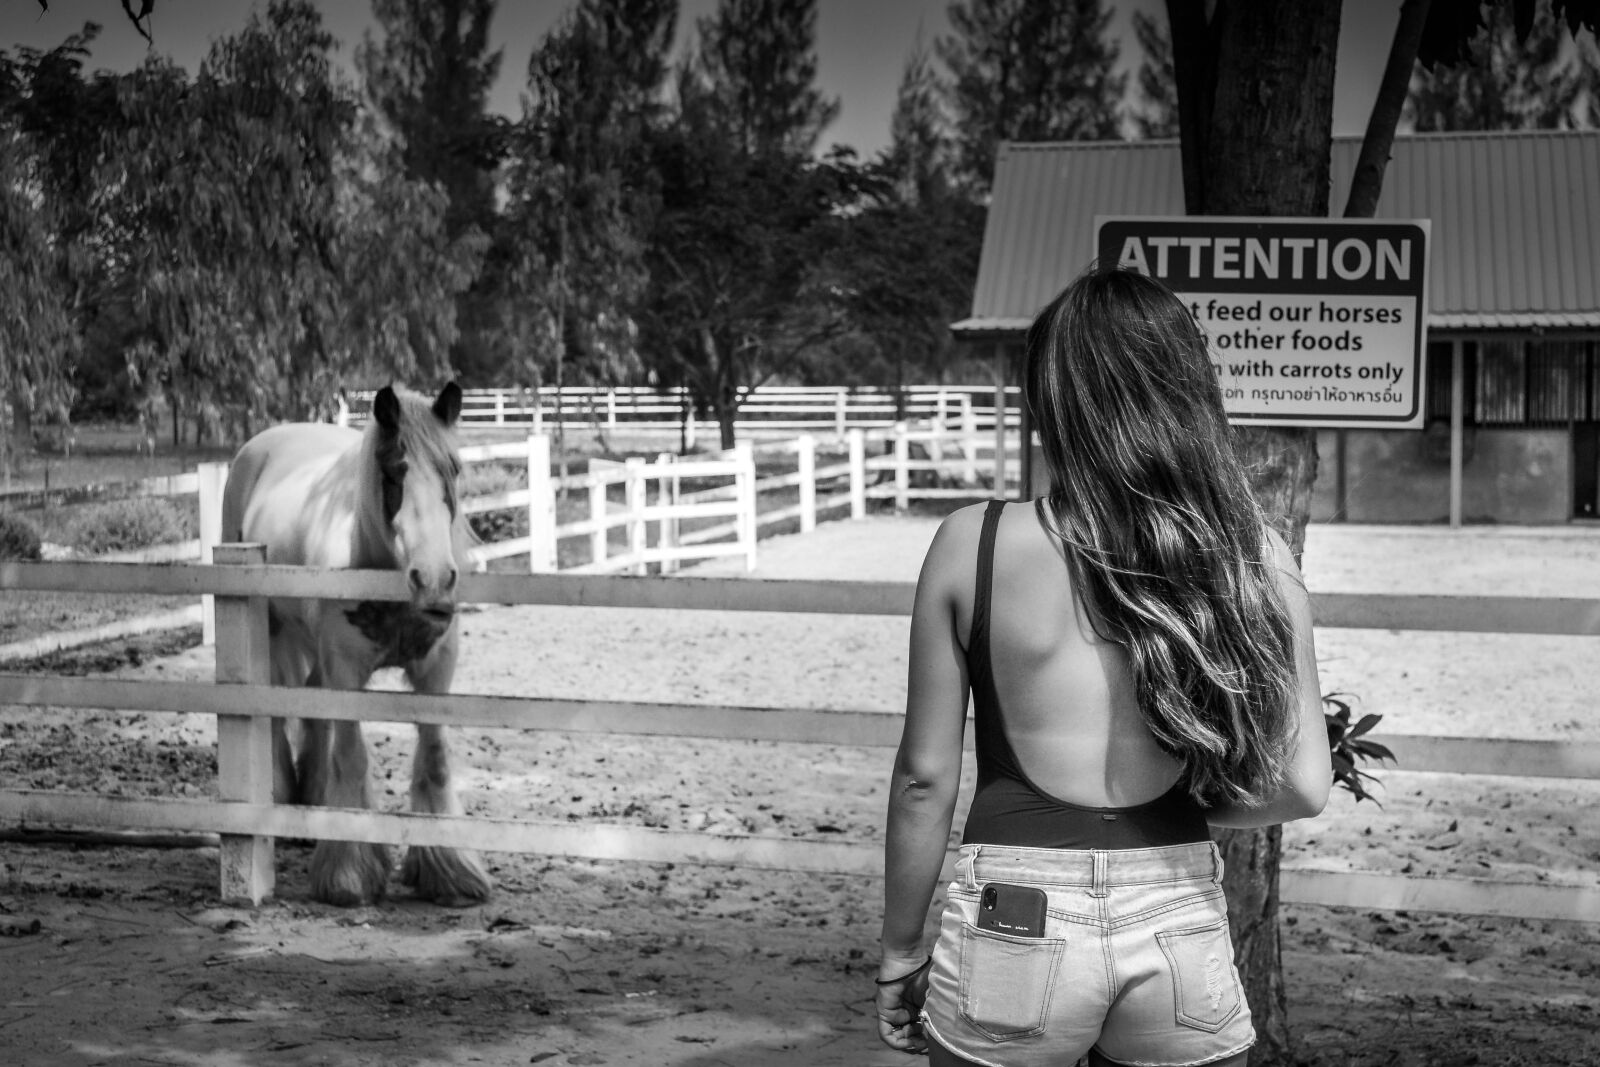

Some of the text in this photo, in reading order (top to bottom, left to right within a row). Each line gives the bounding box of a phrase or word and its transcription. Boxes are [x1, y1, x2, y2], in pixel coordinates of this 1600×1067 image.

[1117, 236, 1411, 281] ATTENTION
[1207, 299, 1261, 321] feed
[1269, 306, 1312, 322] our
[1319, 302, 1402, 324] horses
[1217, 328, 1285, 350] other
[1291, 329, 1362, 351] foods
[1229, 359, 1274, 377] with
[1280, 363, 1352, 379] carrots
[1358, 362, 1403, 384] only
